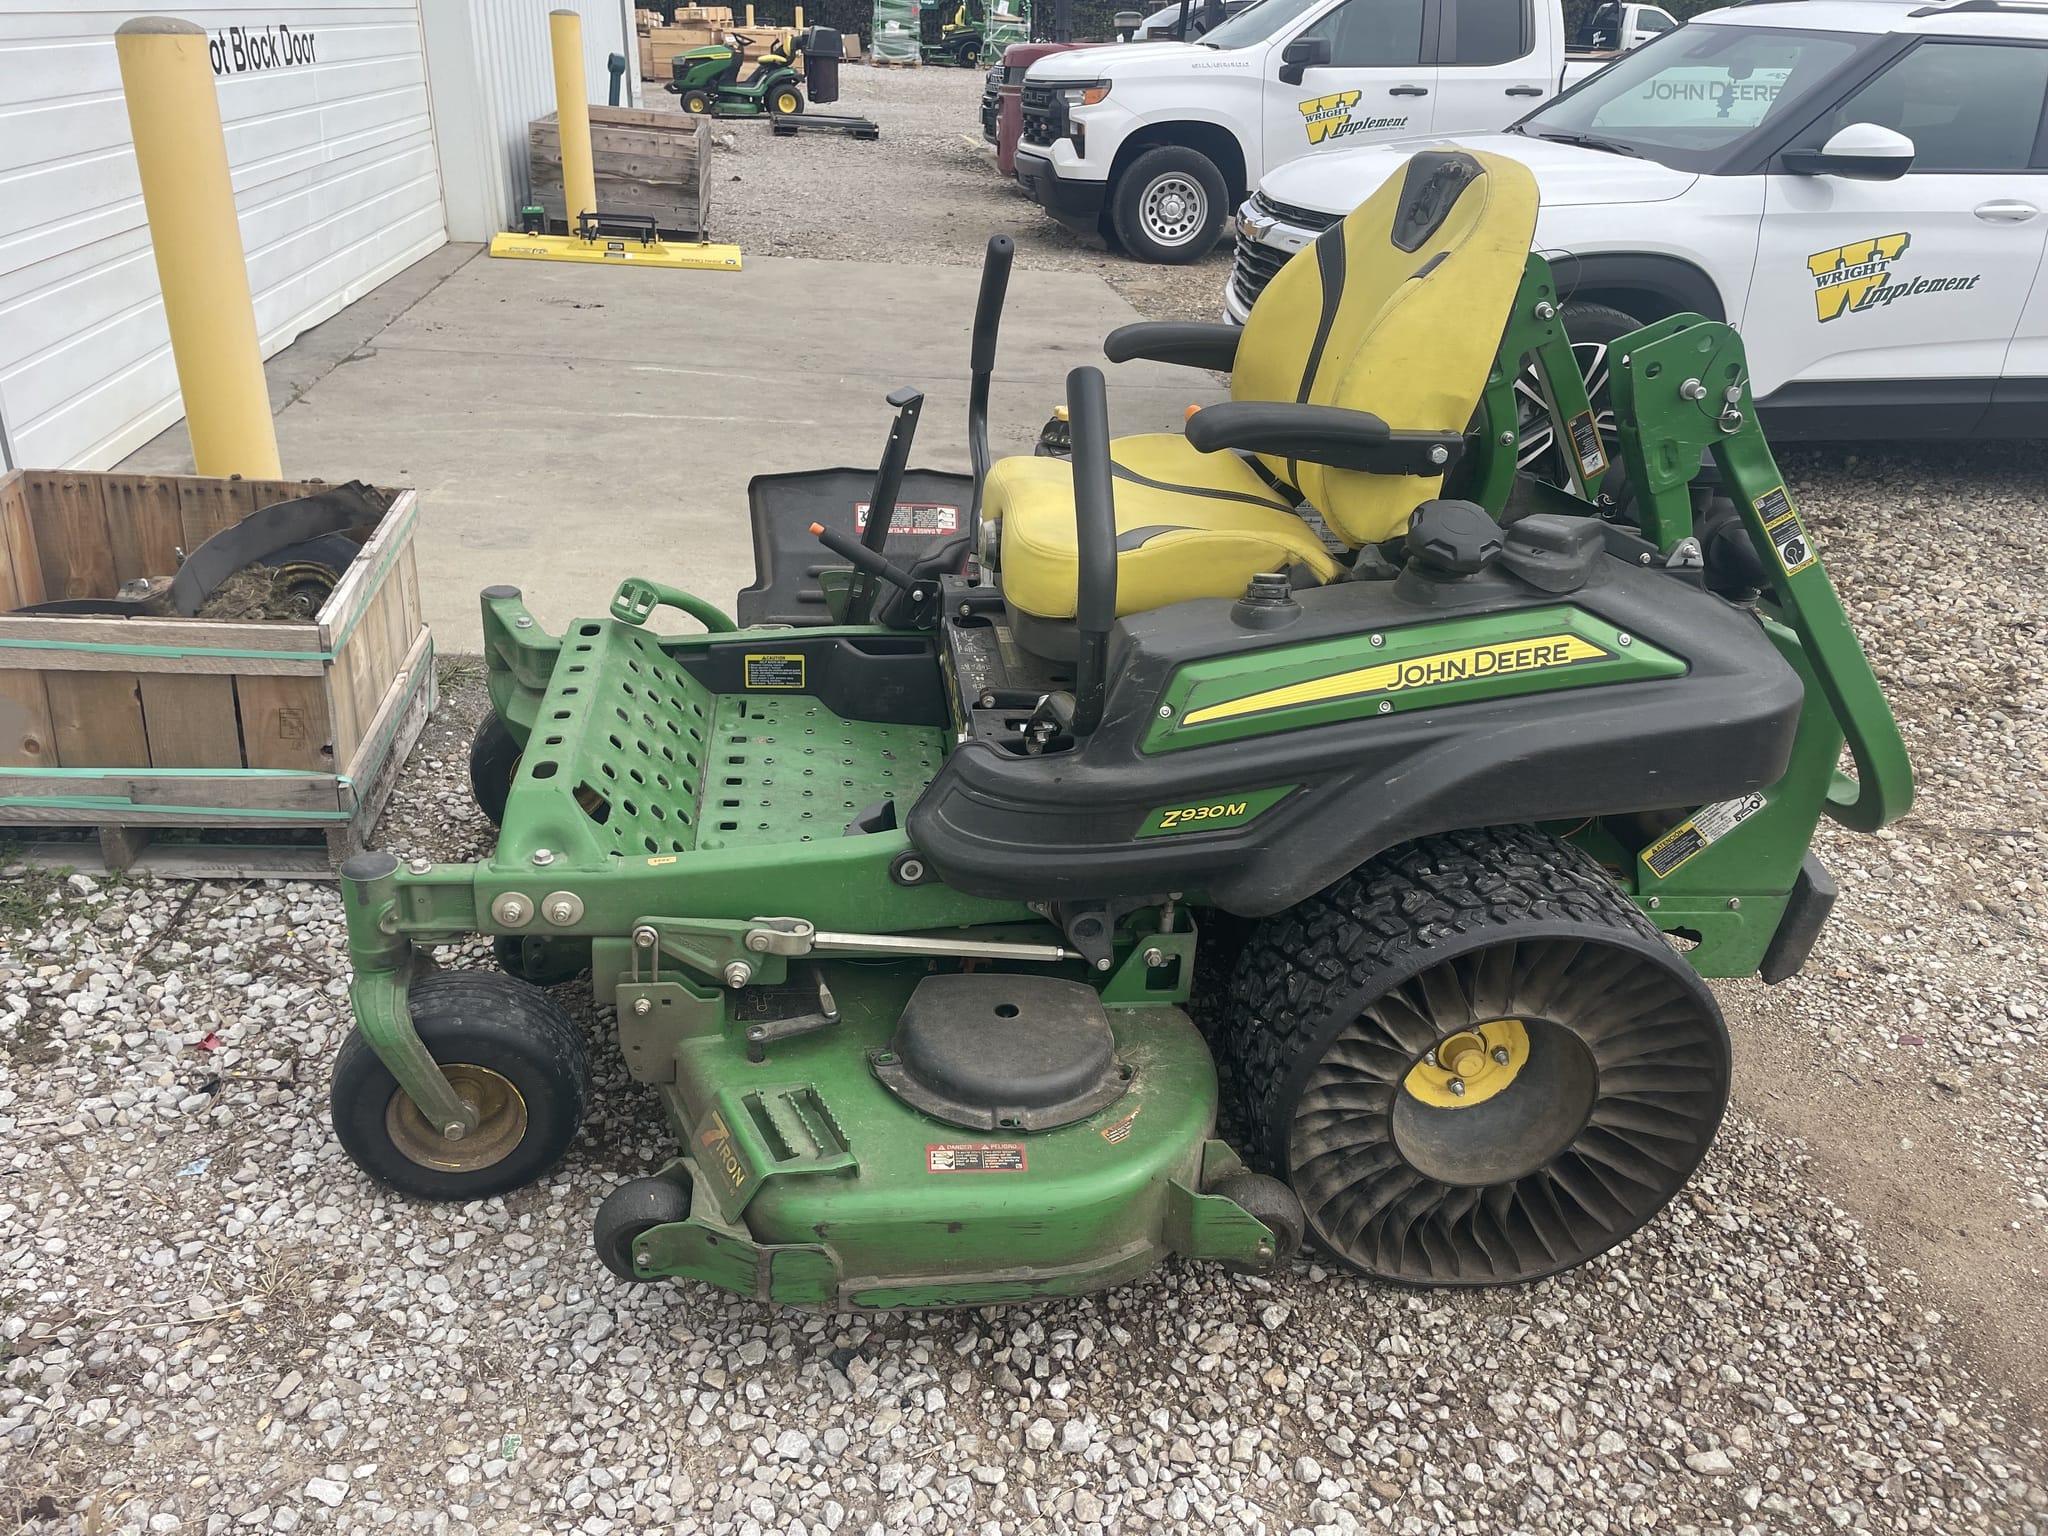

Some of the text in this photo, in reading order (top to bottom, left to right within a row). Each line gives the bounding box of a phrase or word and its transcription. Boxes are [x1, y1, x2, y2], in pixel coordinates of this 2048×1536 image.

[209, 24, 316, 75] ot Block Door
[1642, 80, 1705, 100] JOHN
[1305, 106, 1351, 123] WRIGHT
[1331, 116, 1409, 136] Implement
[1816, 260, 1891, 288] WRIGHT
[1854, 274, 1981, 307] Implement
[1387, 643, 1570, 688] JOHN DEERE
[1159, 802, 1248, 829] Z930M
